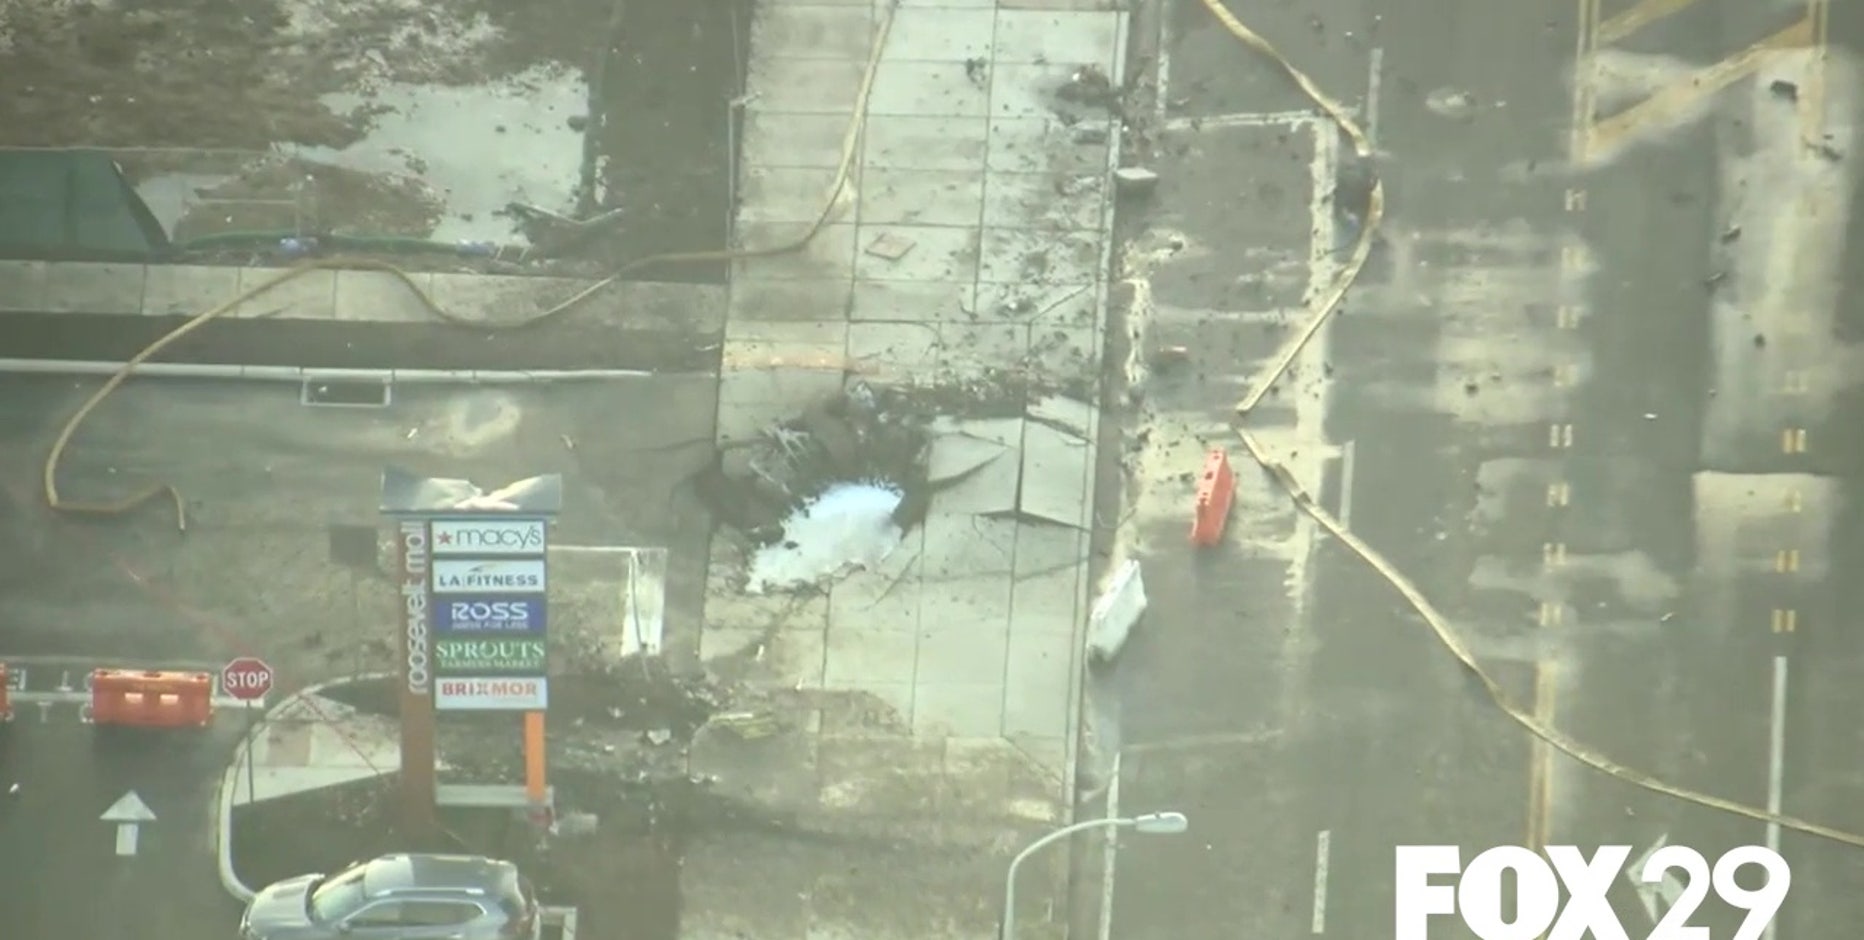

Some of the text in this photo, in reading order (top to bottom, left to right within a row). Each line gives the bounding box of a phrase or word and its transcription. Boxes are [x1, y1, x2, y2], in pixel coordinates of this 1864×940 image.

[456, 526, 542, 549] macy's
[439, 575, 539, 587] LA FITNESS
[401, 521, 427, 694] roosevelt mall
[451, 602, 529, 620] ROSS
[435, 641, 545, 659] SPROUTS
[226, 671, 269, 688] STOP
[442, 683, 537, 696] BRIXMOR
